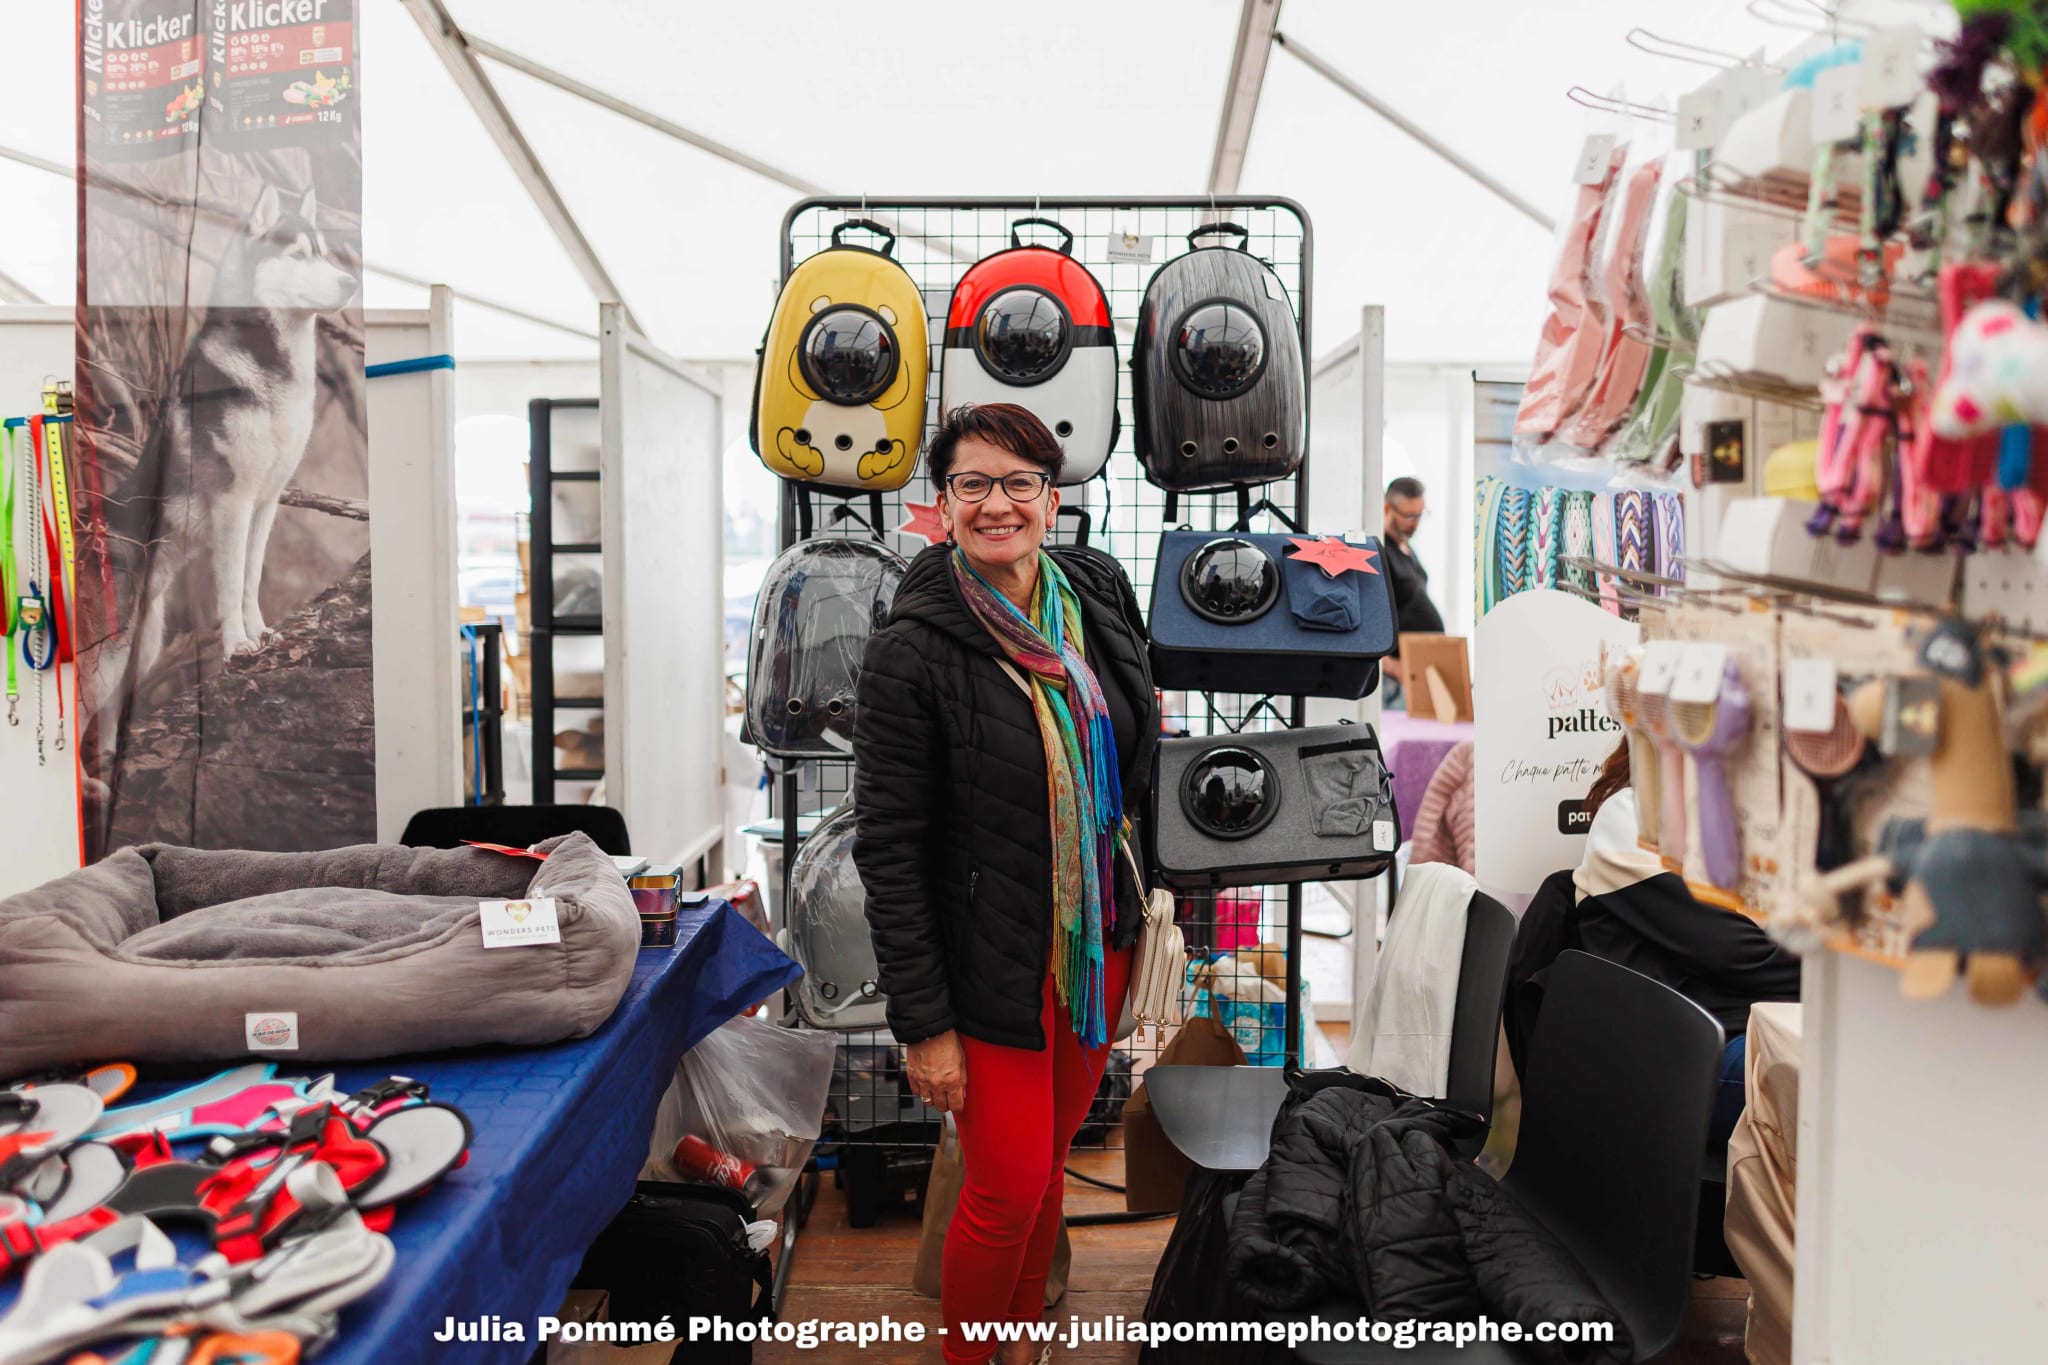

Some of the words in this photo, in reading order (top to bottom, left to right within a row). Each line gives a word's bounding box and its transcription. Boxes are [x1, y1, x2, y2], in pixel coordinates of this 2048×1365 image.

[106, 14, 192, 49] Klicker
[212, 0, 226, 63] Klick
[231, 0, 327, 31] Klicker
[84, 0, 103, 73] Klicke
[1500, 759, 1551, 784] Chaque
[1552, 758, 1592, 783] patte
[487, 927, 533, 936] WONDERS
[535, 925, 556, 933] PETS
